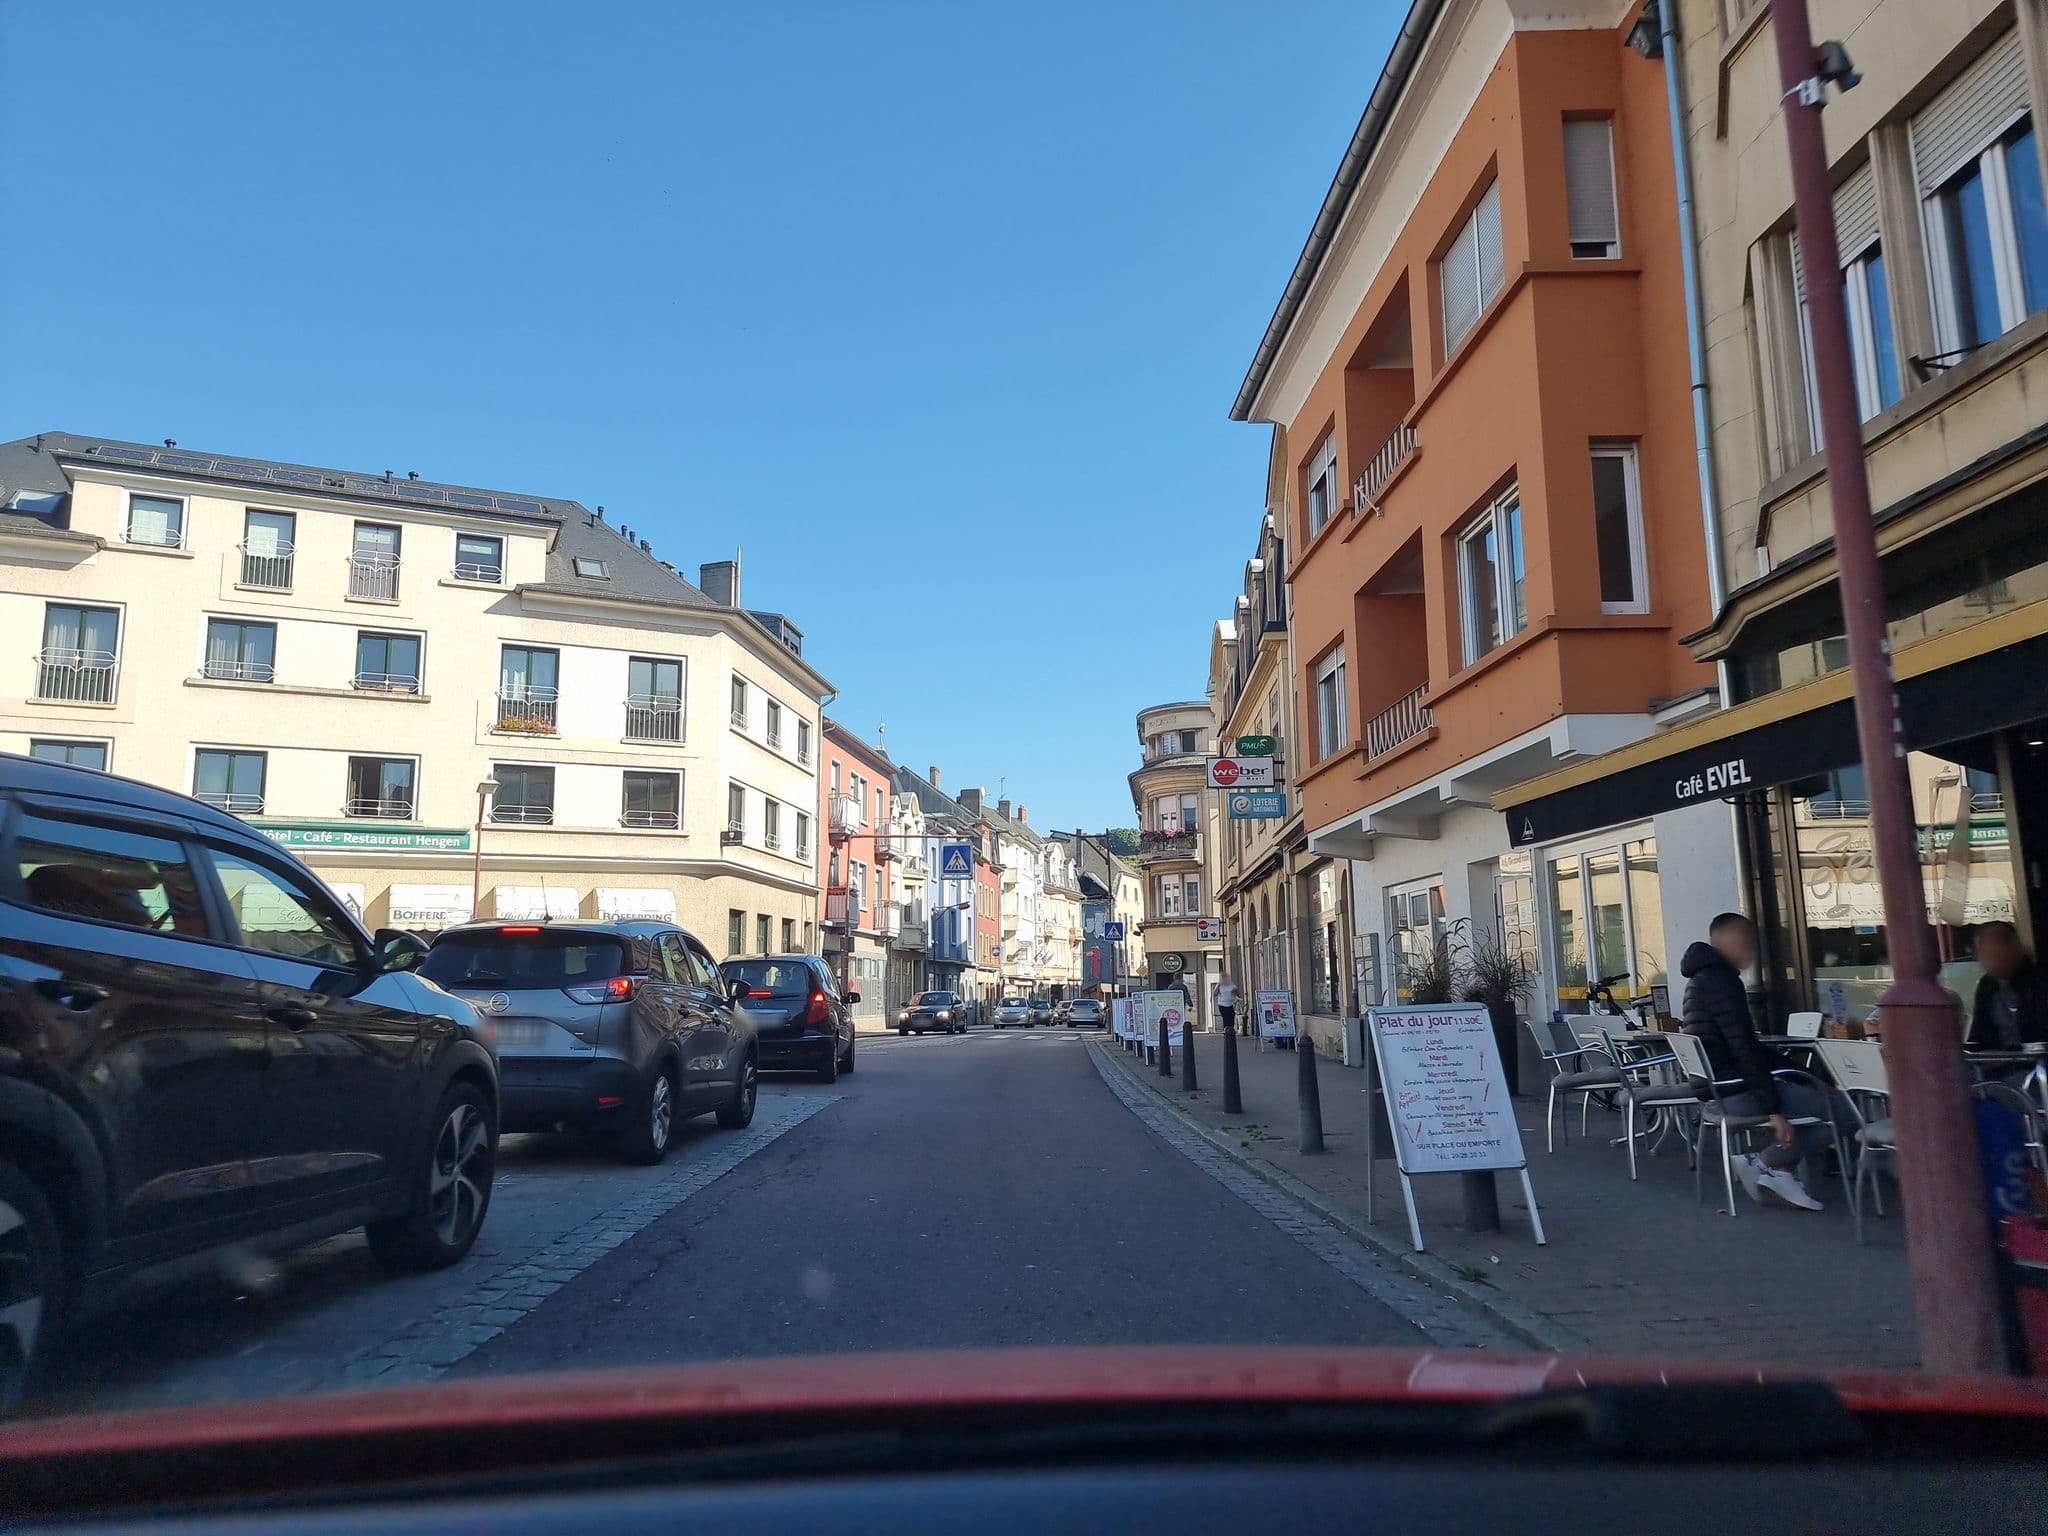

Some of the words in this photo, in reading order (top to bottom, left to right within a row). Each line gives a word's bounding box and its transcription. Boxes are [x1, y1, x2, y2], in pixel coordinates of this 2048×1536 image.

[1241, 742, 1260, 750] PMU
[1213, 766, 1269, 776] weber
[1675, 774, 1704, 799] Café
[1706, 759, 1752, 792] EVEL
[1253, 797, 1279, 807] LOTERIE
[303, 831, 333, 844] Café
[343, 833, 411, 846] Restaurant
[415, 835, 461, 849] Hengen
[1379, 1016, 1405, 1029] Plat
[1407, 1015, 1424, 1027] du
[1428, 1015, 1453, 1029] jour
[1427, 1070, 1458, 1078] Mercredi
[1442, 1120, 1466, 1129] Samedi
[1417, 1142, 1432, 1150] SUR
[1432, 1141, 1455, 1149] PLACE
[1455, 1140, 1466, 1148] OU
